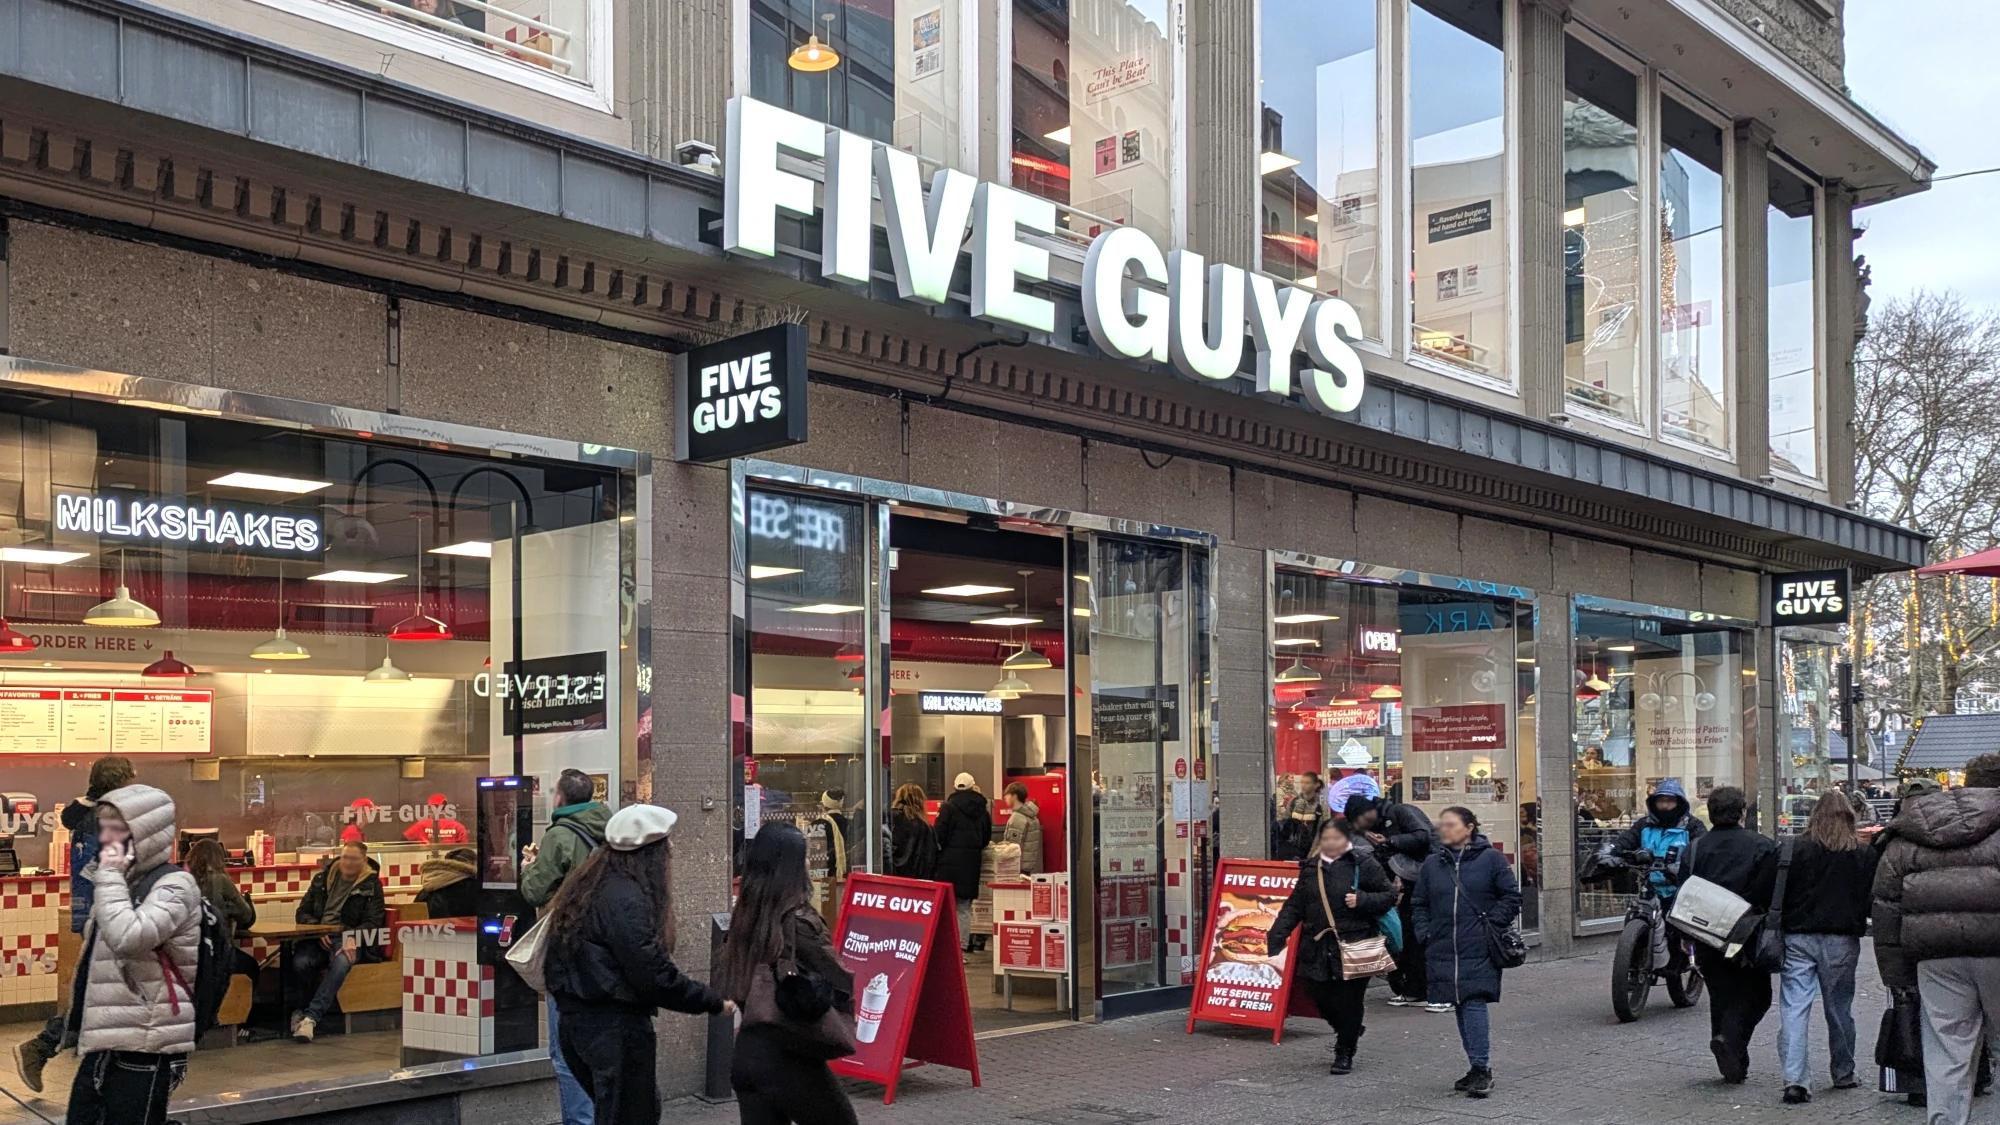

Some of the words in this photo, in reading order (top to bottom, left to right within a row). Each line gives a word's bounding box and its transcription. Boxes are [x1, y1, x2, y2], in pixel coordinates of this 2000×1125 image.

[1119, 57, 1144, 72] Place
[1087, 78, 1110, 93] Can't
[1112, 74, 1123, 85] be
[1429, 224, 1441, 234] and
[1441, 220, 1457, 231] hand
[1457, 219, 1468, 228] cut
[726, 96, 1055, 333] FIVE
[1084, 228, 1364, 413] GUYS
[701, 351, 772, 398] FIVE
[693, 386, 781, 434] GUYS
[57, 494, 318, 551] MILKSHAKES
[1782, 580, 1836, 598] FIVE
[1776, 596, 1843, 615] GUYS
[29, 634, 87, 649] ORDER
[95, 637, 136, 651] HERE
[1366, 630, 1396, 652] OPEN
[545, 697, 564, 708] und
[922, 695, 1003, 712] MILKSHAKES
[1124, 701, 1139, 709] that
[1140, 700, 1155, 709] will
[1100, 714, 1116, 722] tear
[1125, 713, 1143, 722] your
[1315, 708, 1363, 718] RECYCLING
[1321, 716, 1358, 726] STATION
[1421, 725, 1436, 733] fresh
[1436, 725, 1448, 733] and
[1671, 725, 1701, 735] Formed
[1702, 724, 1730, 734] Patties
[1649, 737, 1665, 746] with
[1666, 736, 1702, 746] Fabulous
[343, 805, 392, 824] FIVE
[399, 804, 457, 821] GUYS
[1223, 874, 1256, 887] FIVE
[1259, 876, 1299, 889] GUYS
[852, 892, 887, 909] FIVE
[889, 896, 933, 915] GUYS
[342, 927, 391, 948] FIVE
[398, 923, 456, 944] GUYS
[848, 931, 870, 942] NEUER
[844, 938, 897, 954] CINNAMON
[899, 939, 922, 956] BUN
[894, 951, 917, 963] SHAKE
[1213, 987, 1229, 997] WE
[1228, 988, 1262, 1000] SERVE
[1261, 992, 1272, 1001] IT
[1207, 996, 1229, 1007] HOT
[1229, 999, 1237, 1008] &
[1239, 999, 1273, 1012] FRESH
